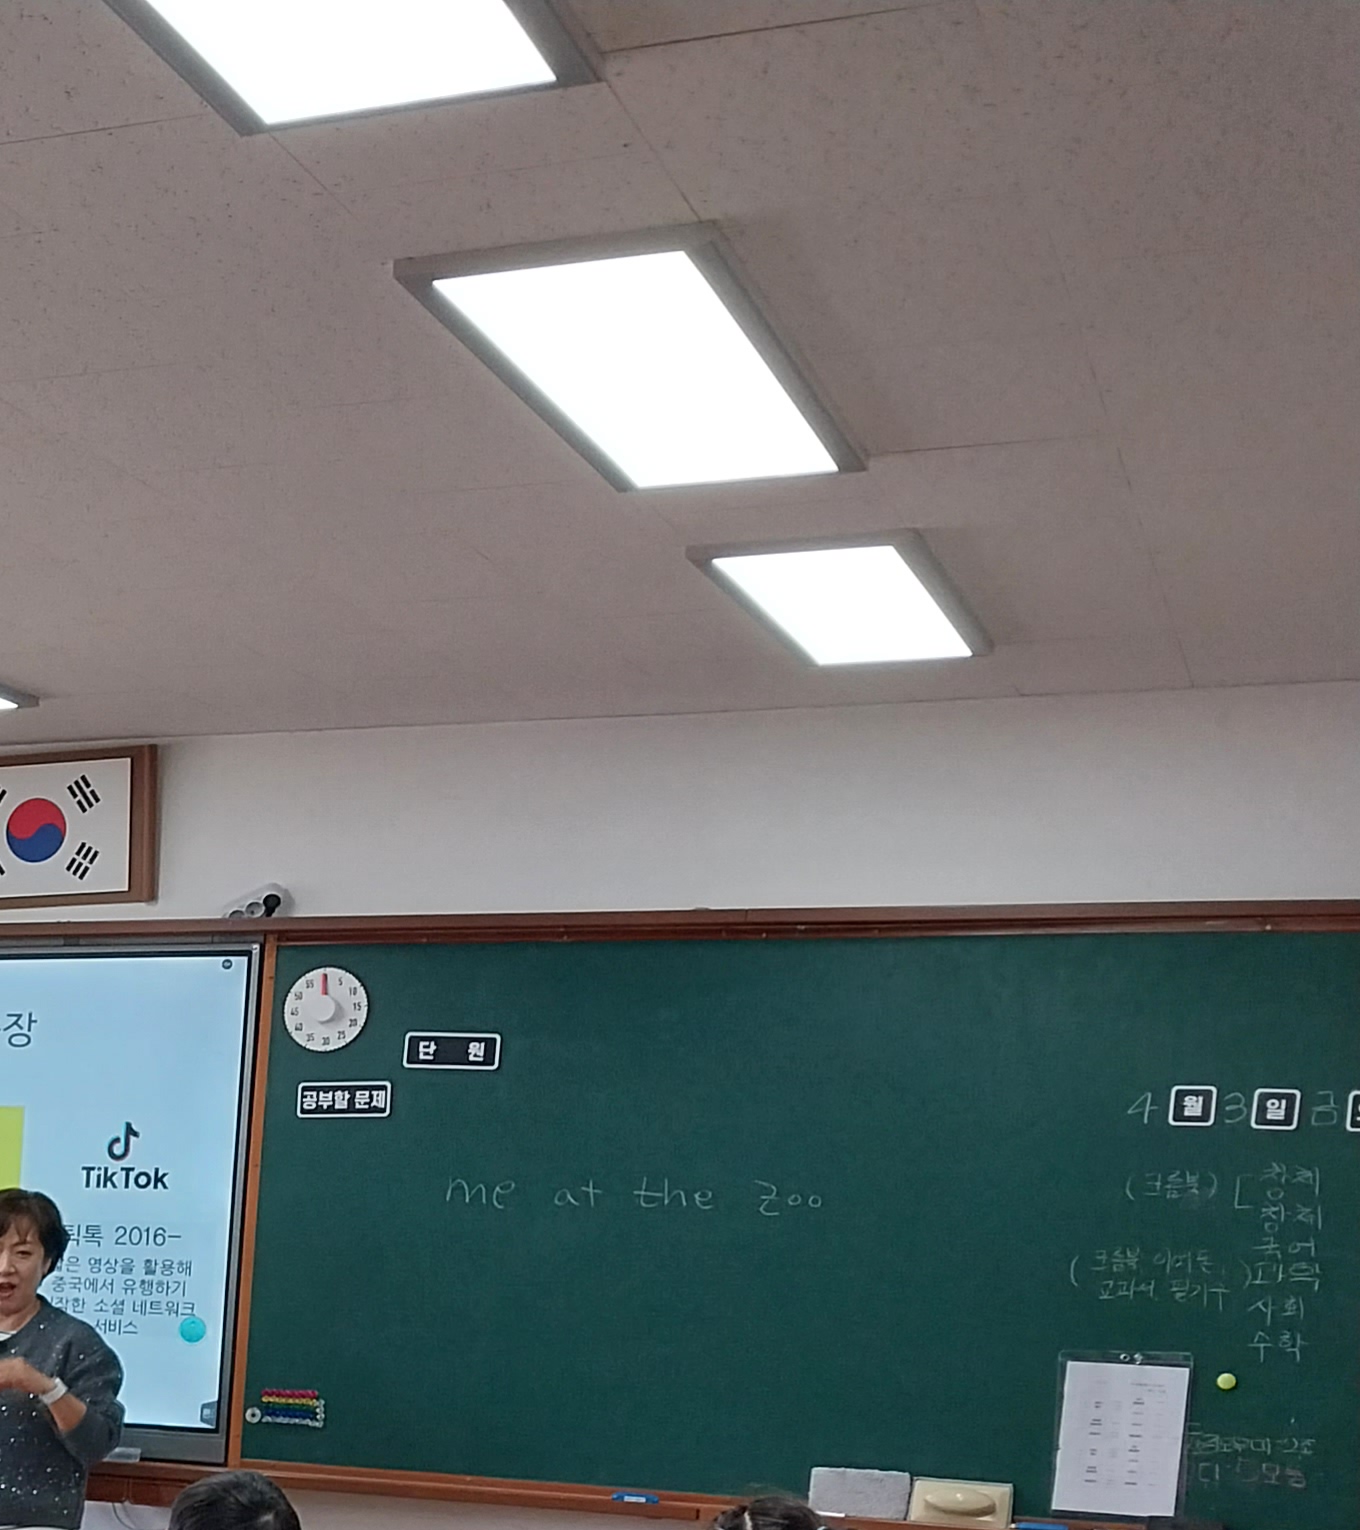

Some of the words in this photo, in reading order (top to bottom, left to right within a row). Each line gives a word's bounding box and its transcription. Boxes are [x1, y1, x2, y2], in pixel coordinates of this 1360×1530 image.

[337, 977, 343, 986] 5
[348, 986, 358, 996] 10
[353, 1002, 362, 1011] 15
[302, 1089, 351, 1110] 공부할
[354, 1089, 386, 1109] 문제
[1127, 1092, 1158, 1124] 4
[1183, 1095, 1204, 1117] 월
[1224, 1092, 1247, 1123] 3
[1266, 1098, 1286, 1120] 일
[81, 1165, 169, 1190] TikTok
[553, 1178, 602, 1208] at
[633, 1176, 714, 1210] the
[114, 1225, 182, 1248] 2016-
[87, 1257, 135, 1275] 영상을
[142, 1258, 193, 1277] 활용해
[51, 1276, 114, 1294] 중국에서
[121, 1278, 188, 1298] 유행하기
[48, 1296, 87, 1314] 작한
[94, 1298, 126, 1315] 소셜
[132, 1299, 196, 1319] 네트워크
[94, 1319, 139, 1336] 서비스
